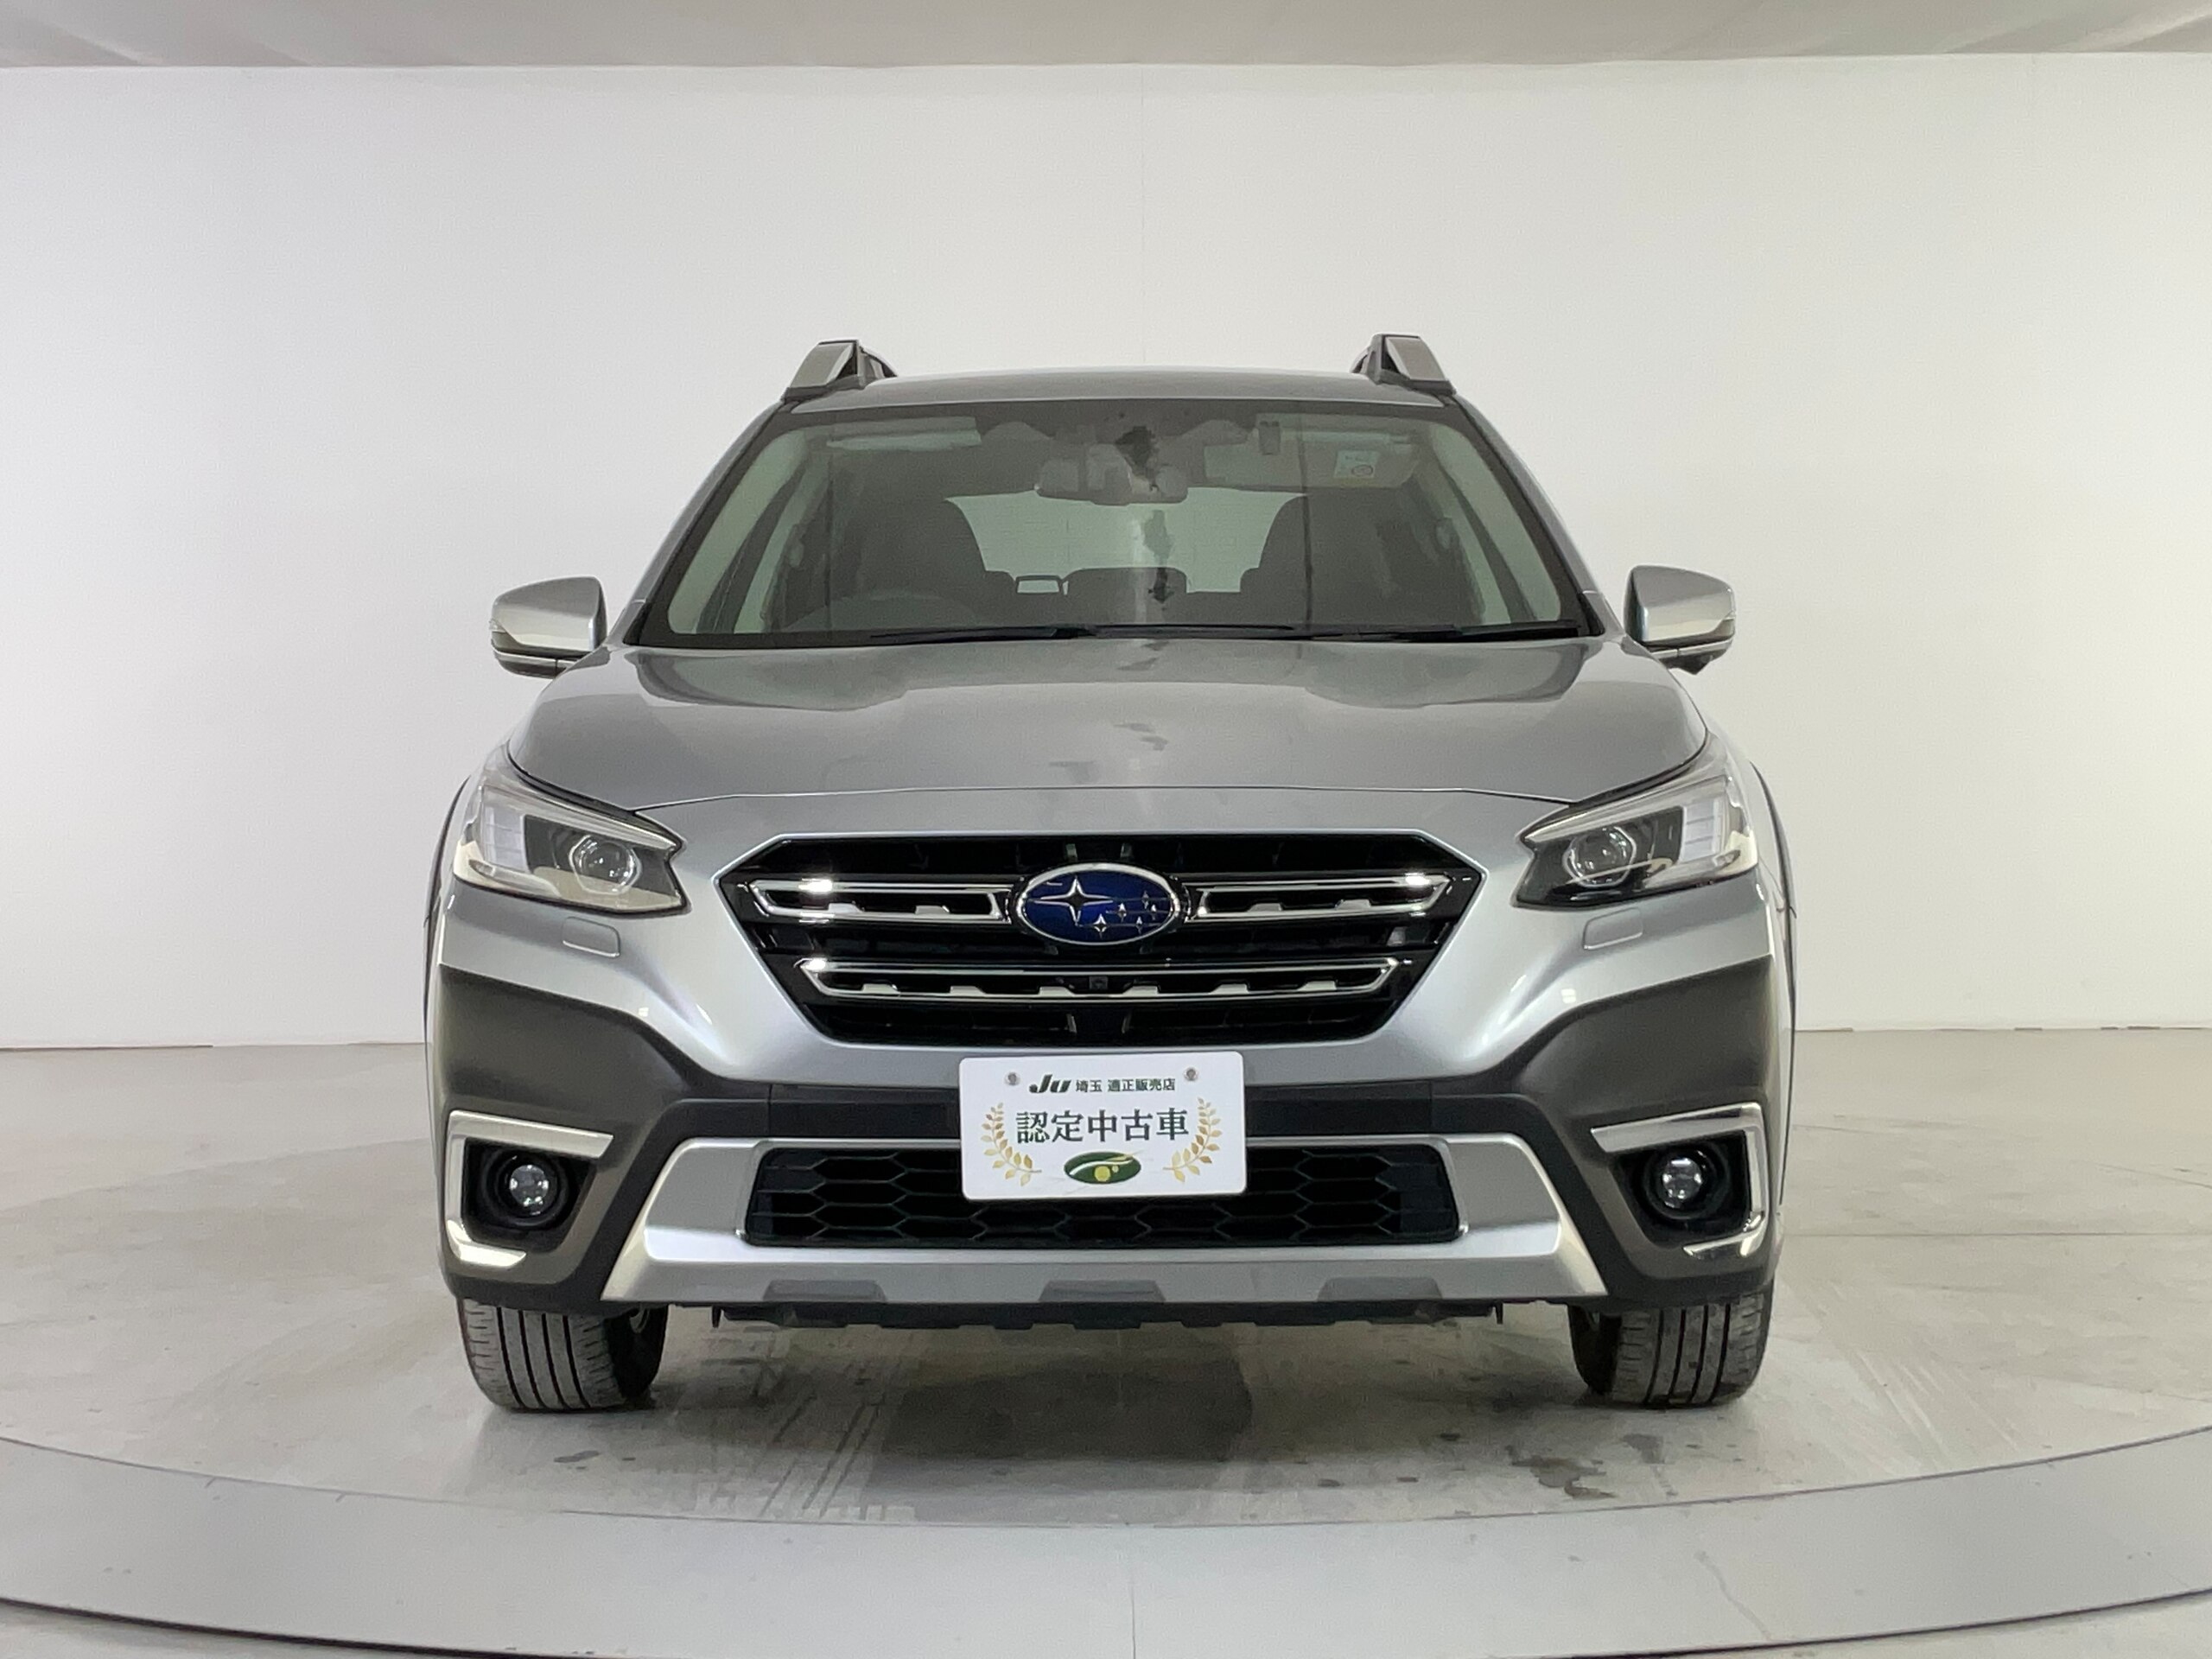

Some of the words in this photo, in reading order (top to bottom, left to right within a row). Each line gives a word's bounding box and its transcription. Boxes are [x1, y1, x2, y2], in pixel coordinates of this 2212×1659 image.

[1076, 1079, 1102, 1092] 埼玉
[1108, 1078, 1175, 1092] 適正販売店
[1016, 1107, 1189, 1143] 認定中古車
